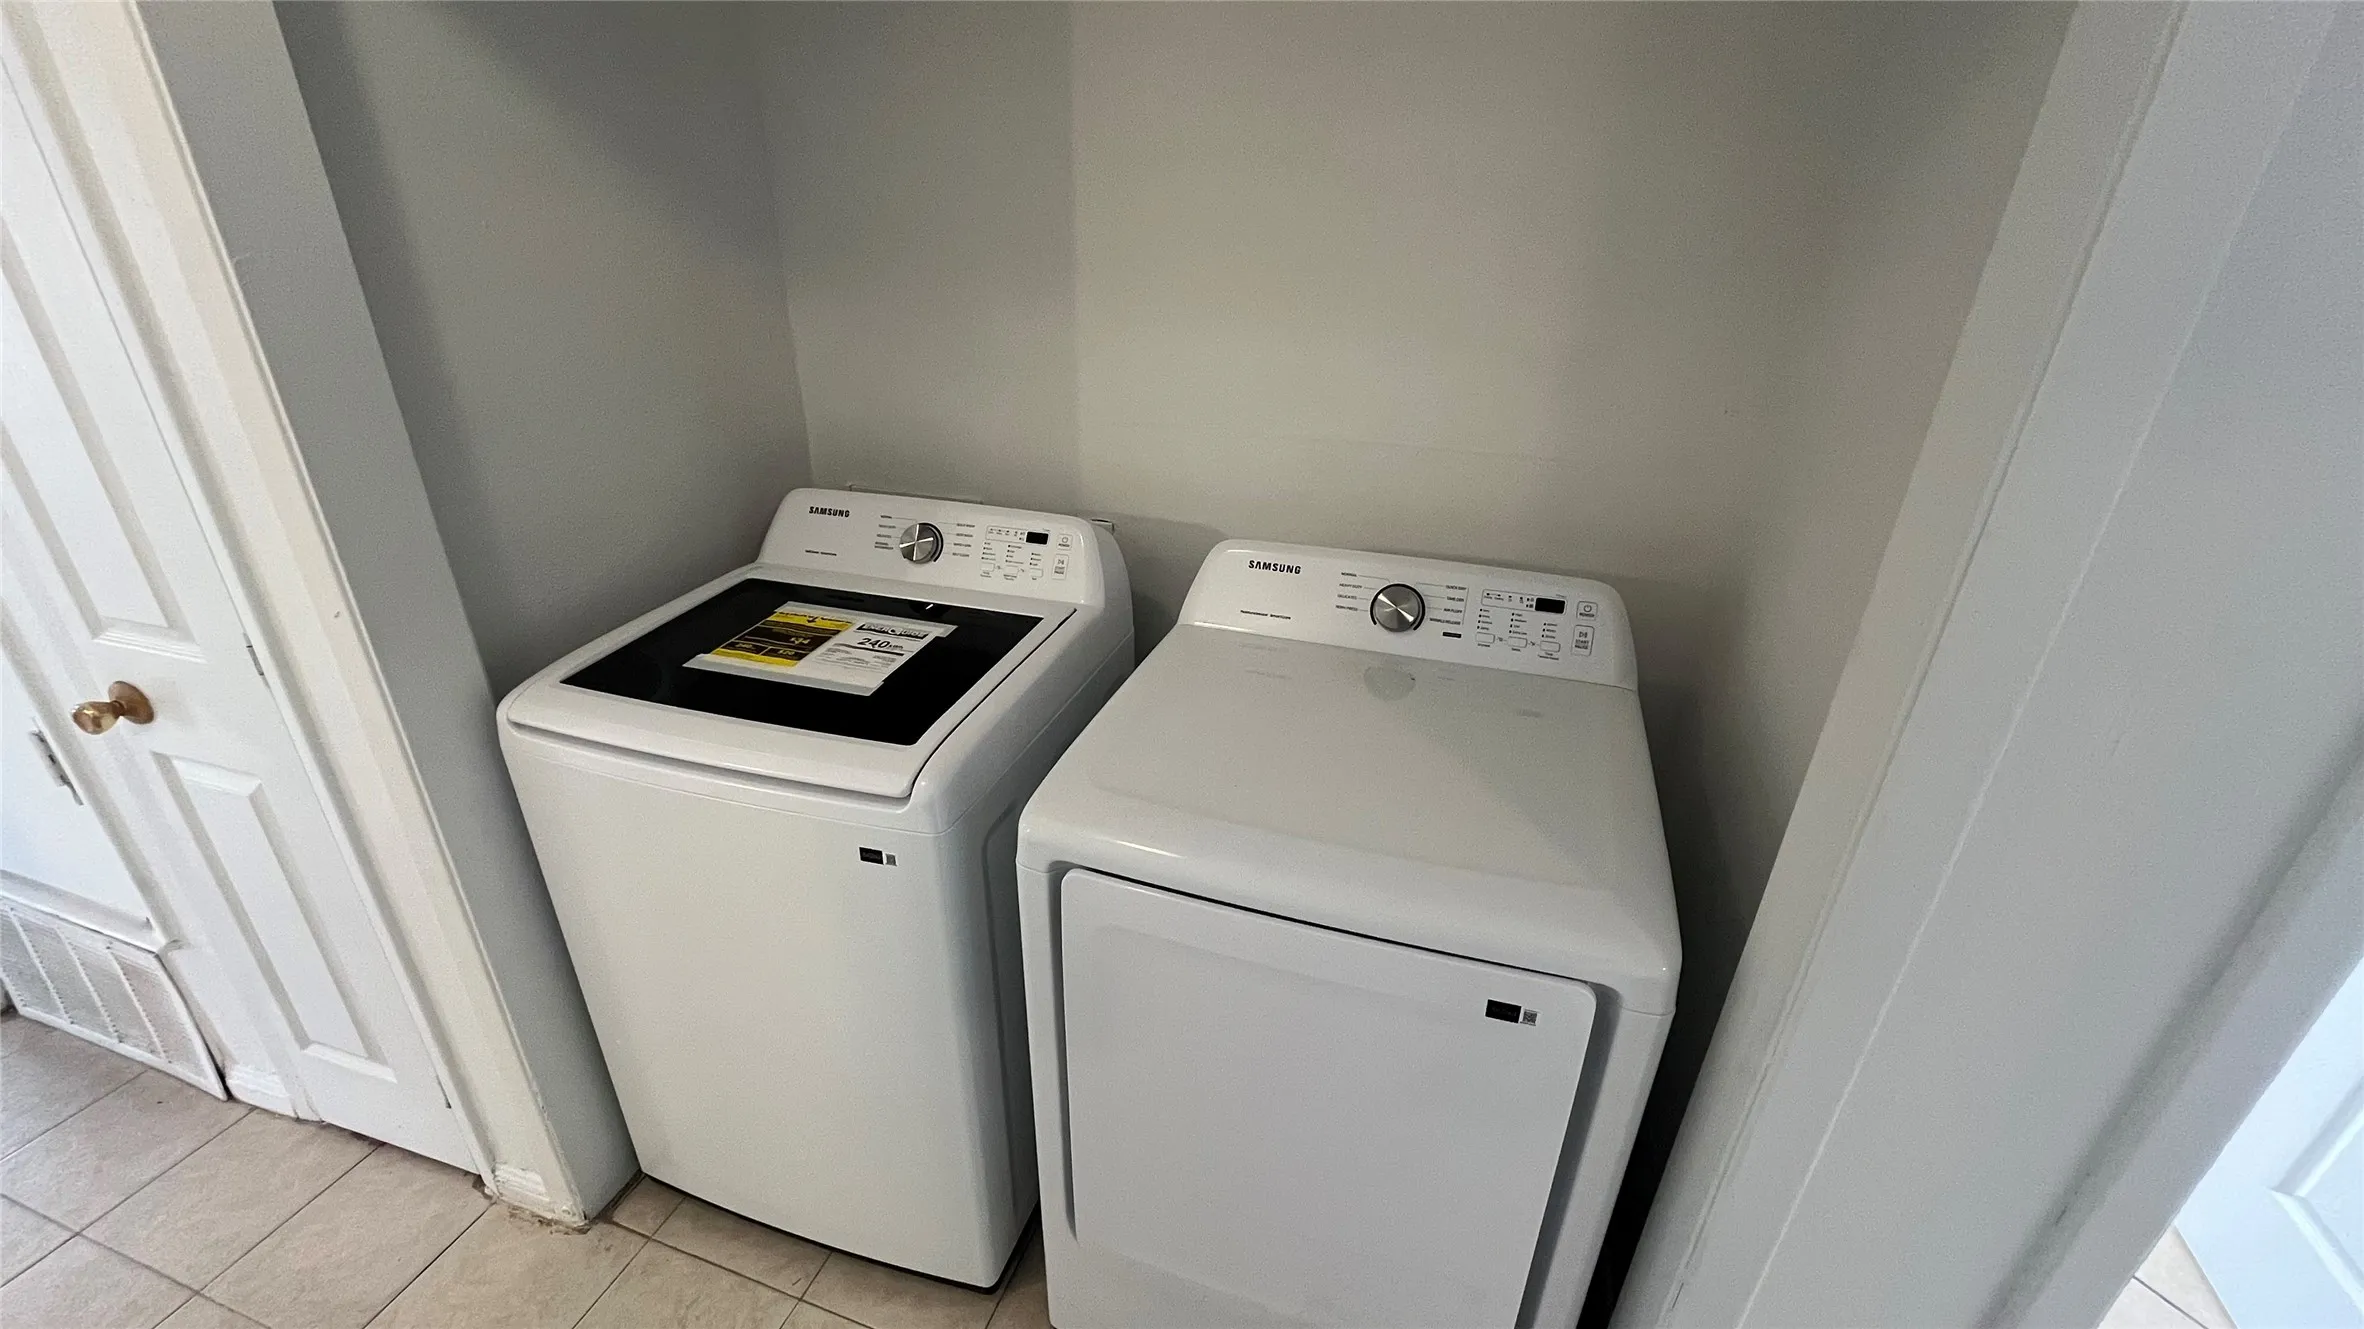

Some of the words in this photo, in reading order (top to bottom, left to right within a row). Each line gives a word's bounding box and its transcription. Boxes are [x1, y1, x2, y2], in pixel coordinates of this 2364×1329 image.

[809, 506, 850, 518] SAMSUNG
[1248, 560, 1301, 575] SAMSUNG
[857, 637, 890, 649] 240
